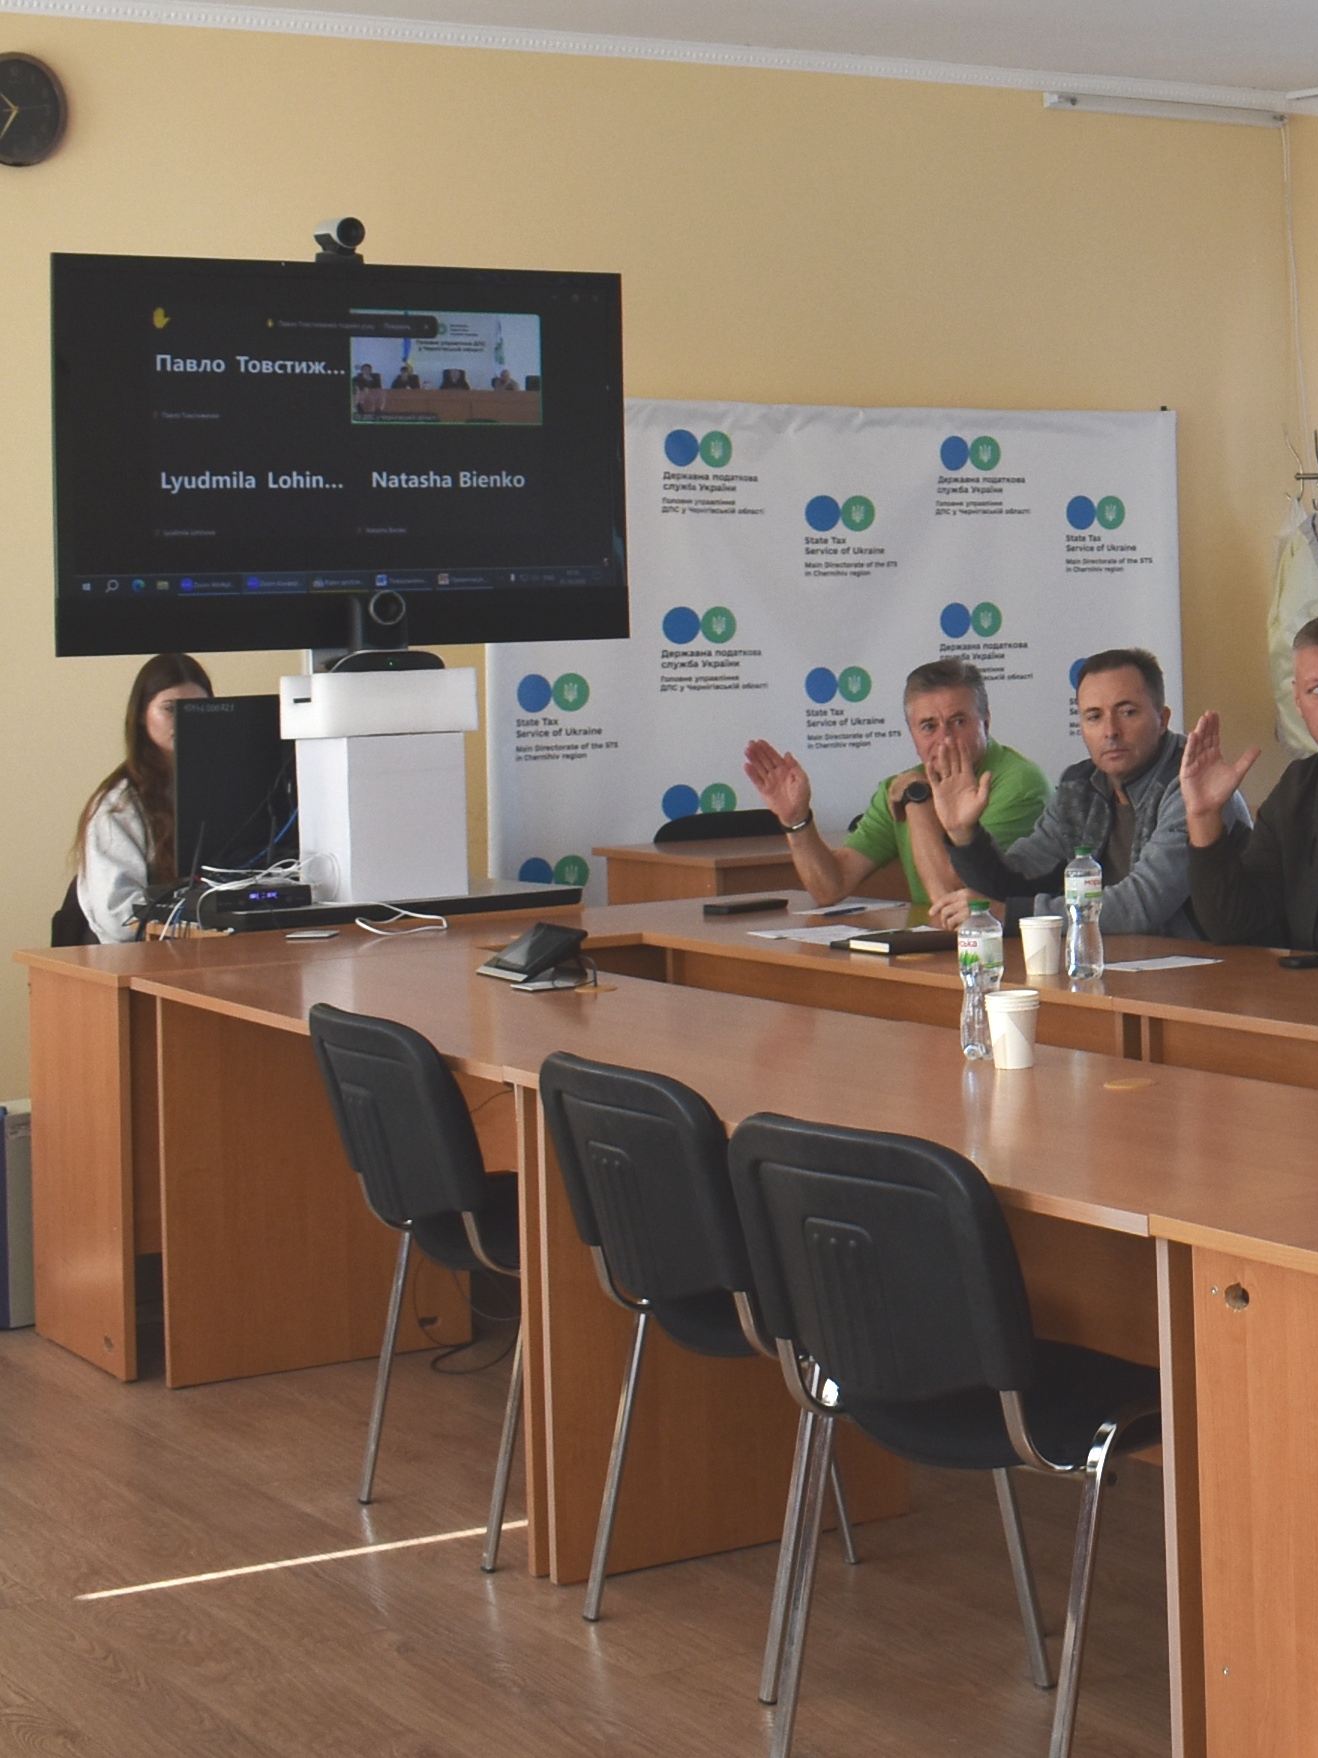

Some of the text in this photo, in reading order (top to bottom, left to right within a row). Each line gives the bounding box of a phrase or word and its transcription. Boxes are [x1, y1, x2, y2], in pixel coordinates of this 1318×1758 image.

[156, 354, 226, 372] Павло
[371, 470, 526, 488] Natasha Bienko
[663, 472, 758, 482] Державна податкова
[938, 476, 980, 484] Державна
[160, 471, 256, 494] Lyudmila
[663, 483, 736, 492] служба України
[937, 486, 1003, 494] служба України
[831, 536, 846, 544] Tax
[841, 546, 850, 554] of
[940, 643, 980, 652] Державна
[661, 649, 712, 658] Державна
[972, 651, 1005, 660] України
[661, 659, 739, 669] служба України
[517, 719, 539, 727] State
[839, 718, 848, 726] of
[851, 717, 884, 725] Ukraine
[517, 727, 602, 738] Service of Ukraine
[959, 940, 978, 948] ська
